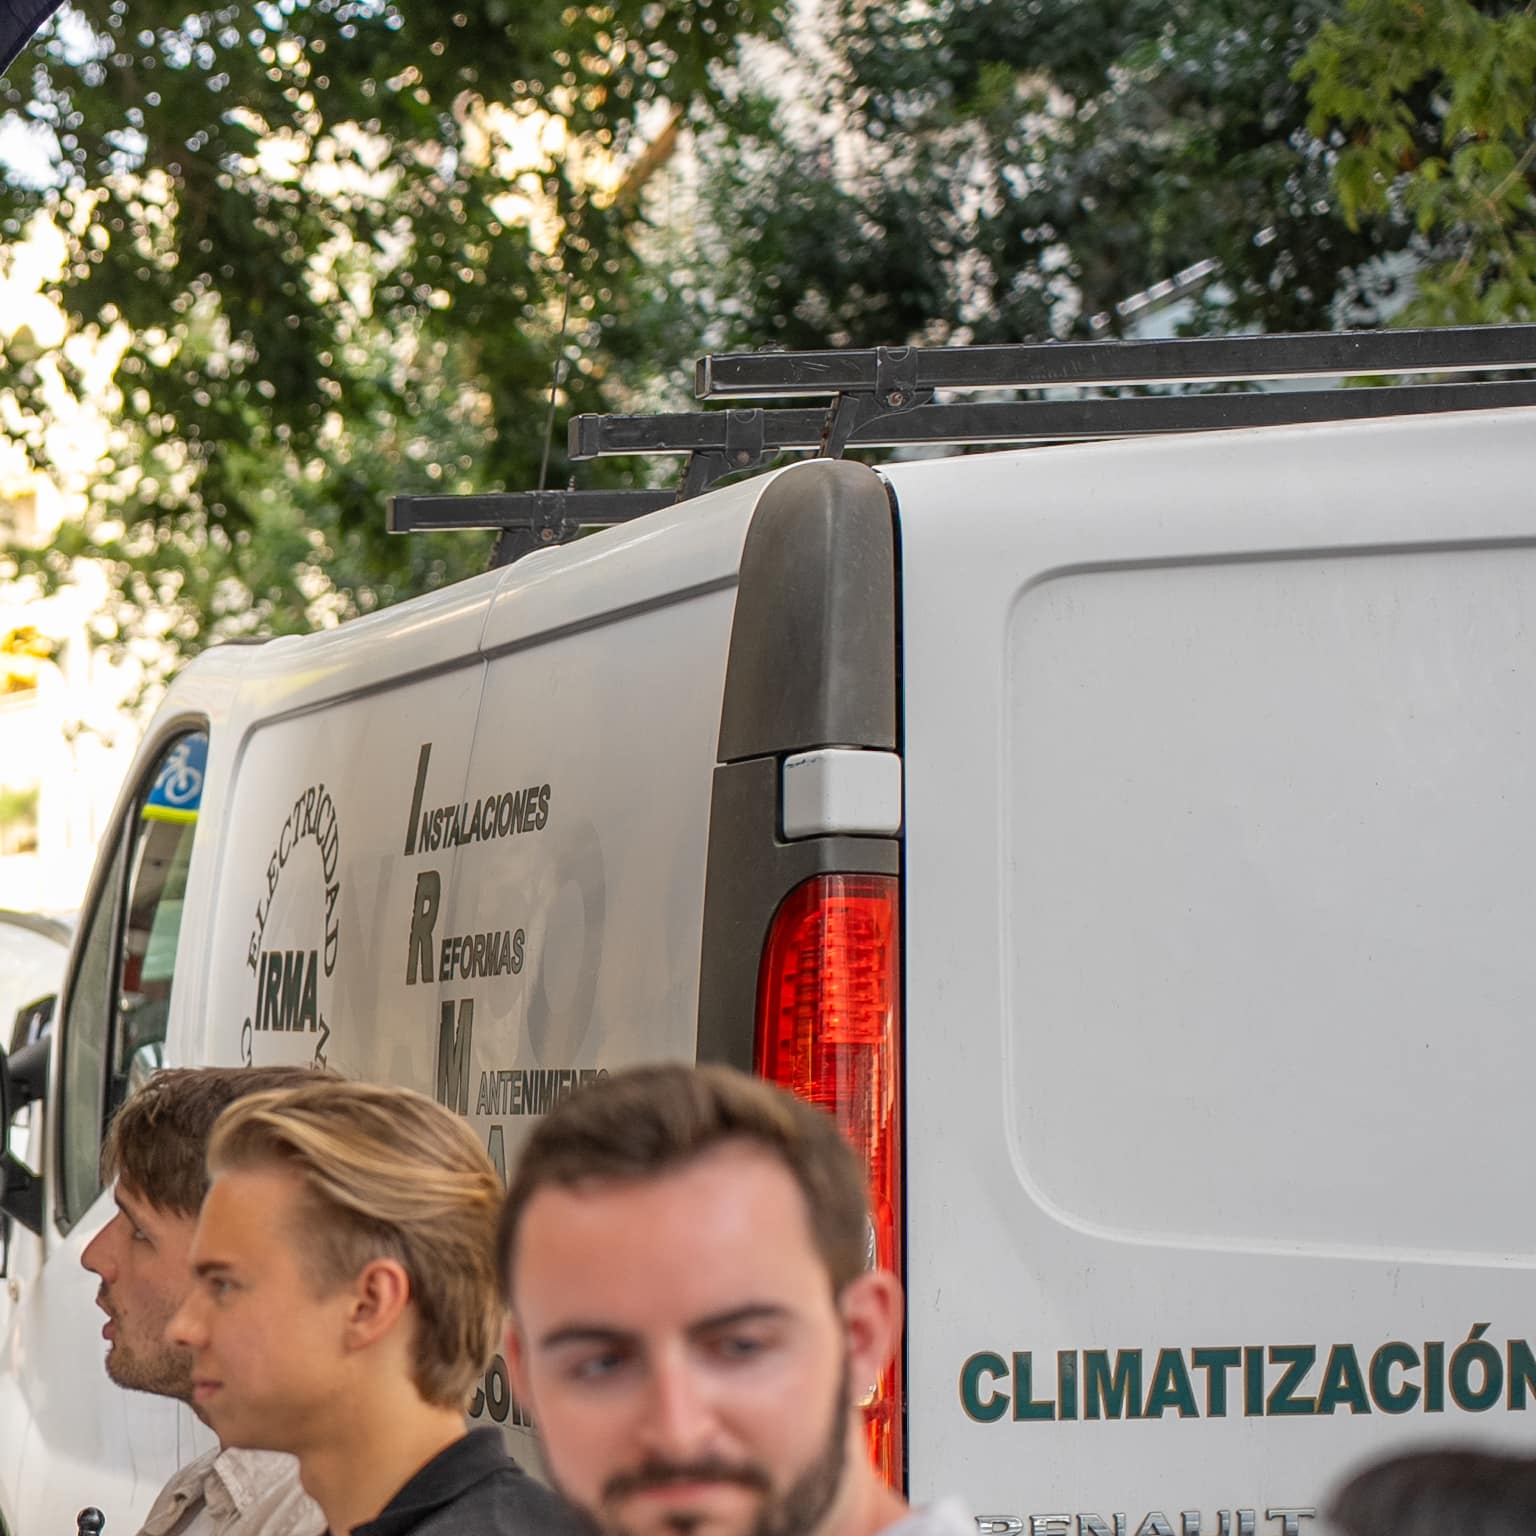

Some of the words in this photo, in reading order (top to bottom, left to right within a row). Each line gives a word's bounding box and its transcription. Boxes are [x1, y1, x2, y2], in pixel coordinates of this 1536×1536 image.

[247, 783, 339, 978] ELECTRICIDAD
[254, 950, 318, 1032] IRMA
[437, 998, 610, 1117] MANTENIMI
